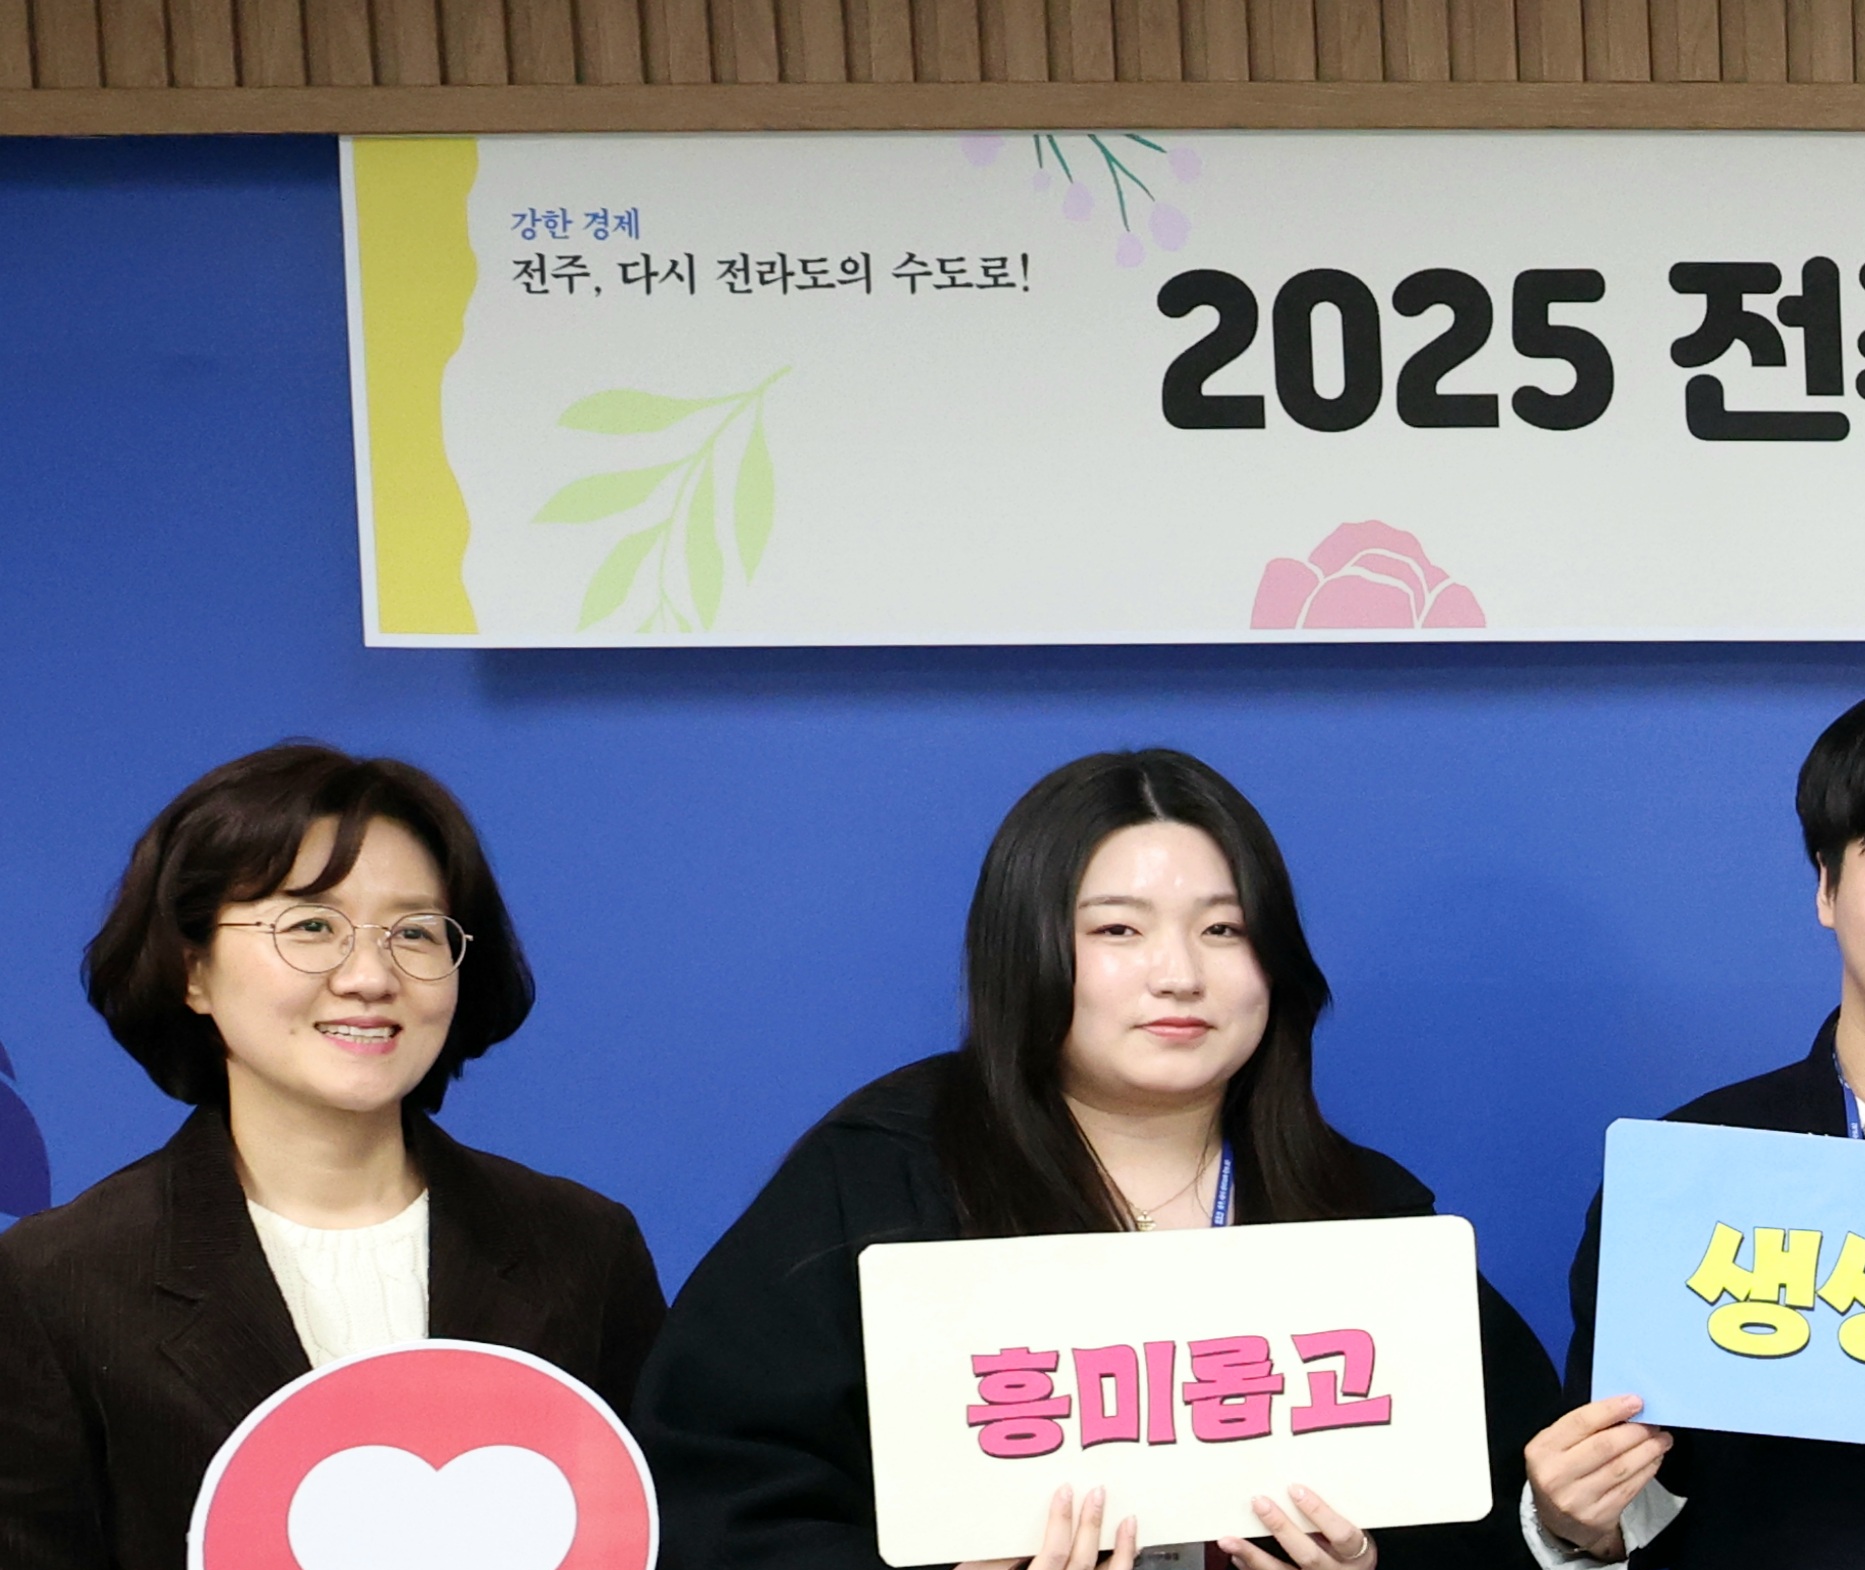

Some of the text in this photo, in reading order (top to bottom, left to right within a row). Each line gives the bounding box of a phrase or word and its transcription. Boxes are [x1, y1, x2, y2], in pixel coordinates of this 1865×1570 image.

[512, 207, 640, 241] 강한 경제
[512, 250, 1031, 297] 전주, 다시 전라도의 수도로!
[1156, 267, 1615, 434] 2025
[966, 1328, 1392, 1459] 흥미롭고
